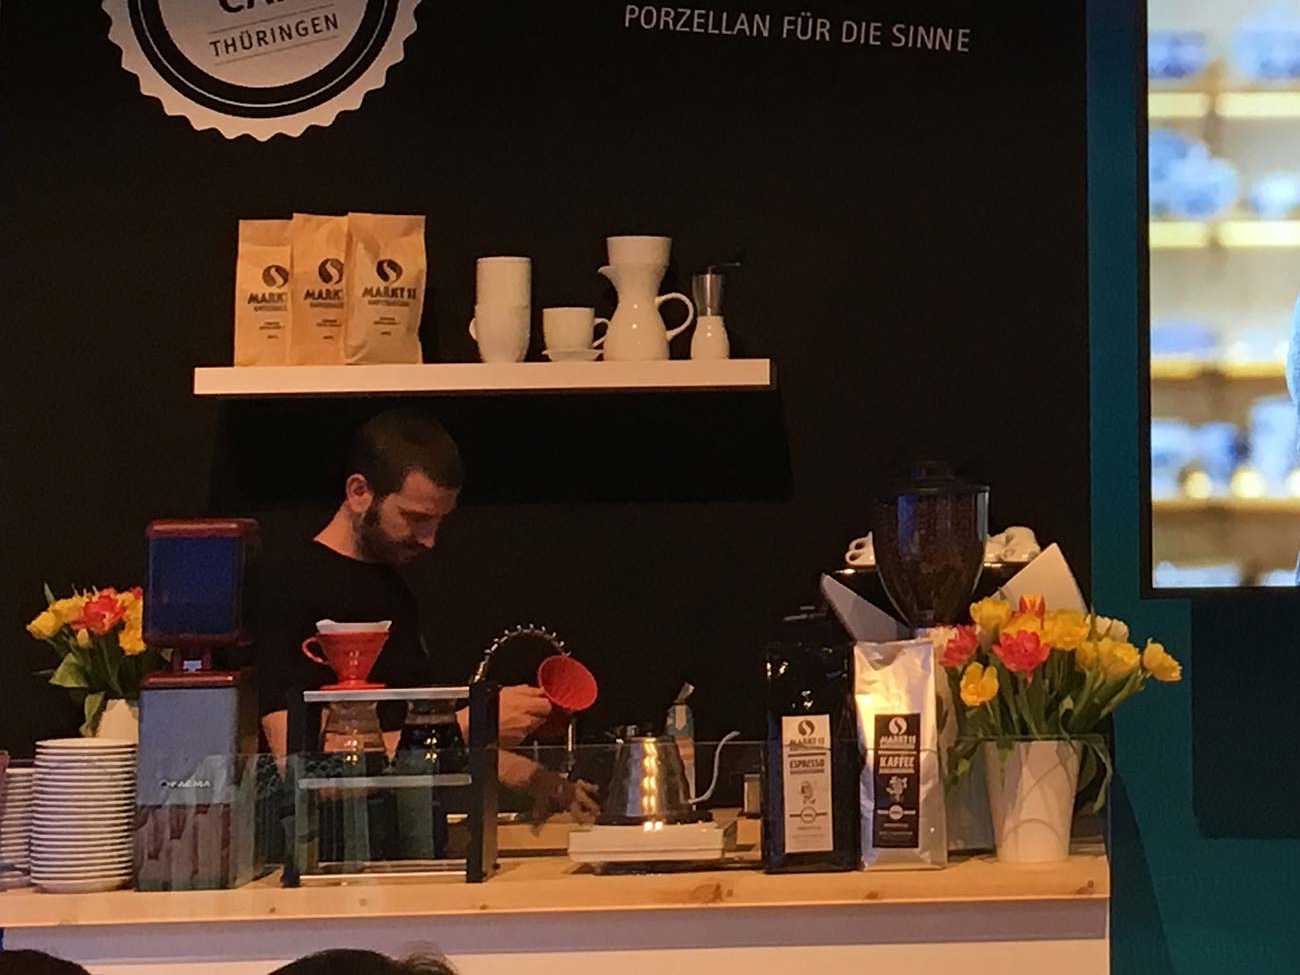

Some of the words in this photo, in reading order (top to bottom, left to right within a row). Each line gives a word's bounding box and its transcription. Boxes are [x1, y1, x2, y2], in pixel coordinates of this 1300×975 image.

[209, 13, 339, 57] THÜRINGEN
[624, 5, 771, 38] PORZELLAN
[782, 12, 831, 41] FÜR
[841, 21, 882, 45] DIE
[891, 24, 971, 52] SINNE
[304, 288, 344, 301] MARK
[789, 758, 825, 769] ESPRESSO
[879, 756, 916, 767] KAFFEE
